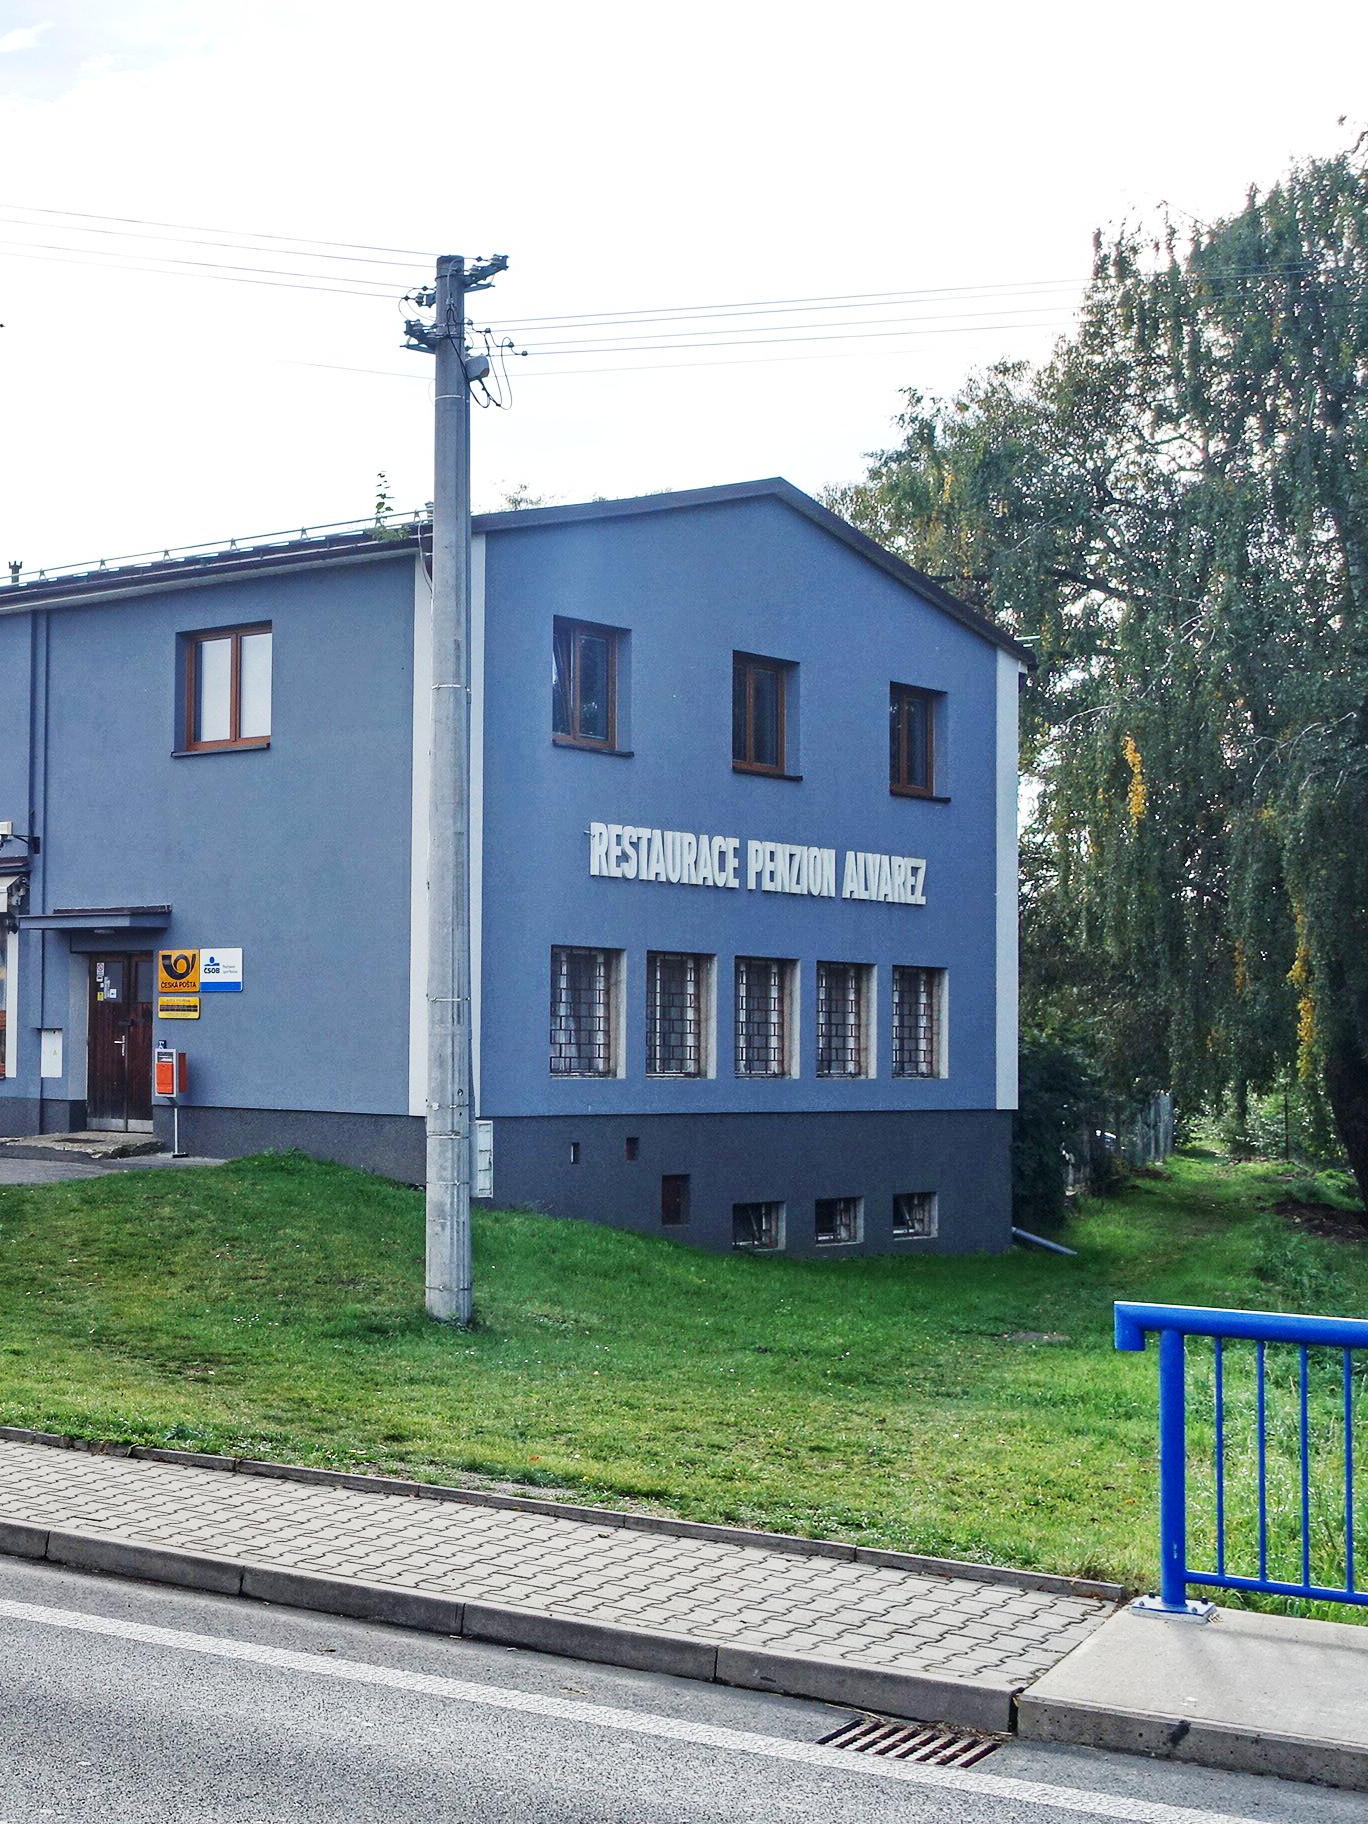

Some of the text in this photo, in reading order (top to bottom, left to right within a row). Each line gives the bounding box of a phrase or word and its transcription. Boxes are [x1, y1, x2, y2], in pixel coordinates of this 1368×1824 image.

[590, 821, 927, 905] RESTAURACE PENZION ALVAREZ
[161, 980, 197, 989] ČESKÁ POŠTA
